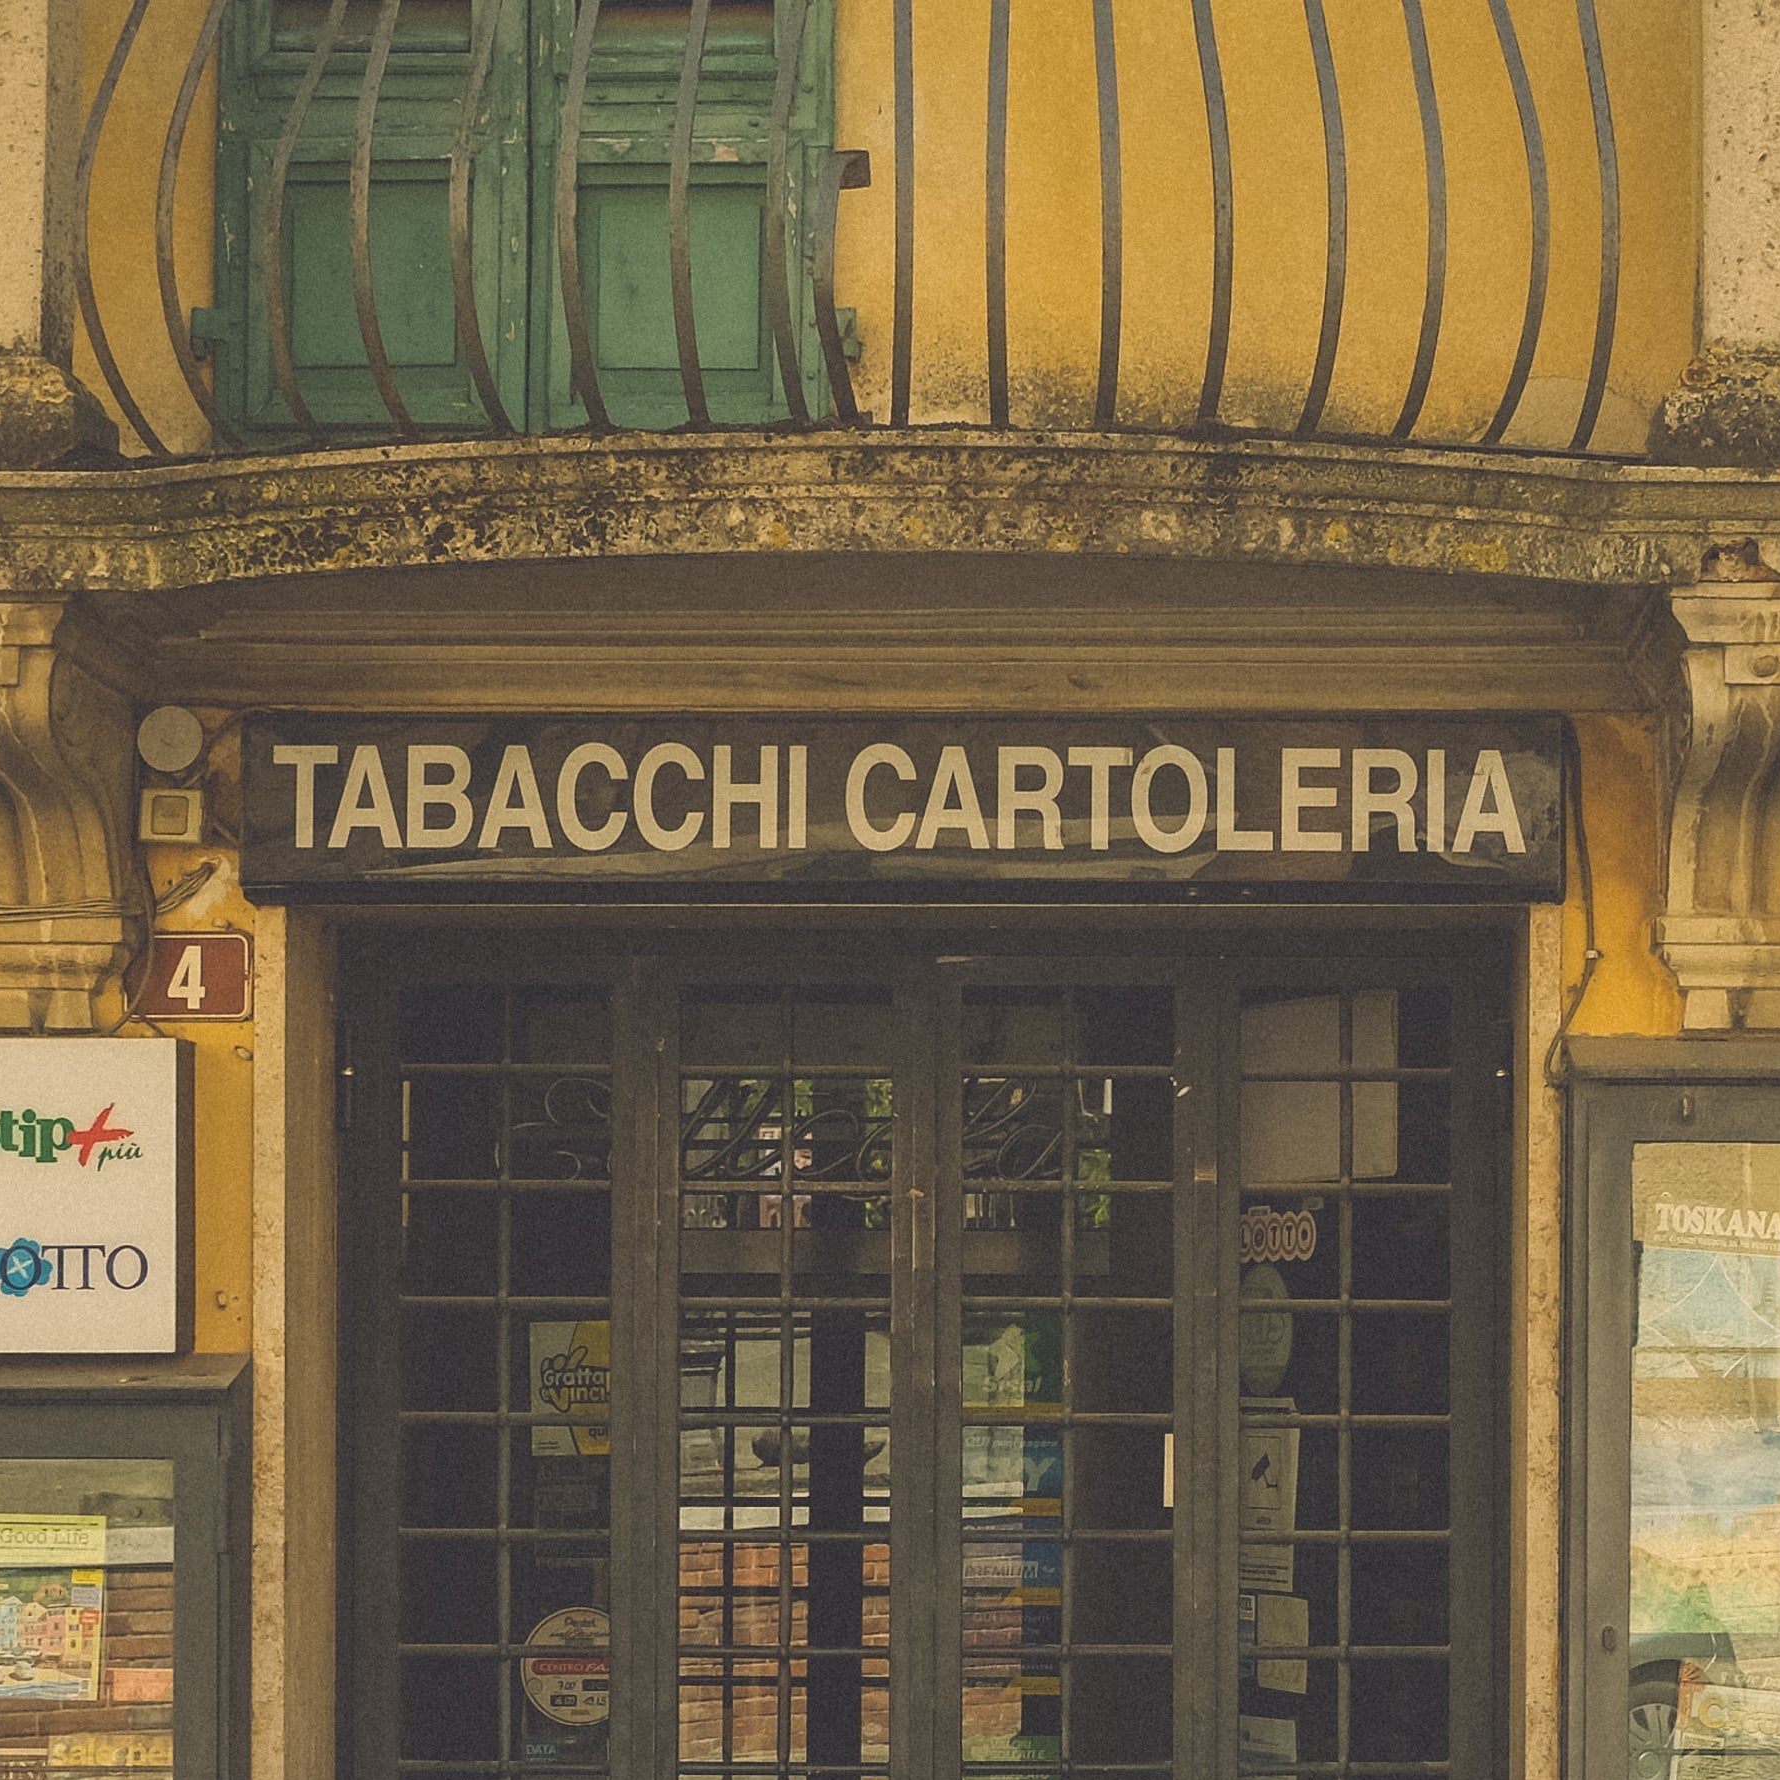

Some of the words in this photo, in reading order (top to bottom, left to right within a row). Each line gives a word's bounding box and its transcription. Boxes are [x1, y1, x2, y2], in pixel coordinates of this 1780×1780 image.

[272, 742, 809, 852] TABACCHI
[844, 744, 1530, 855] CARTOLERIA
[166, 945, 207, 1010] 4
[542, 1368, 605, 1386] Gratta
[51, 1526, 90, 1546] Life
[538, 1661, 583, 1673] CENTRO
